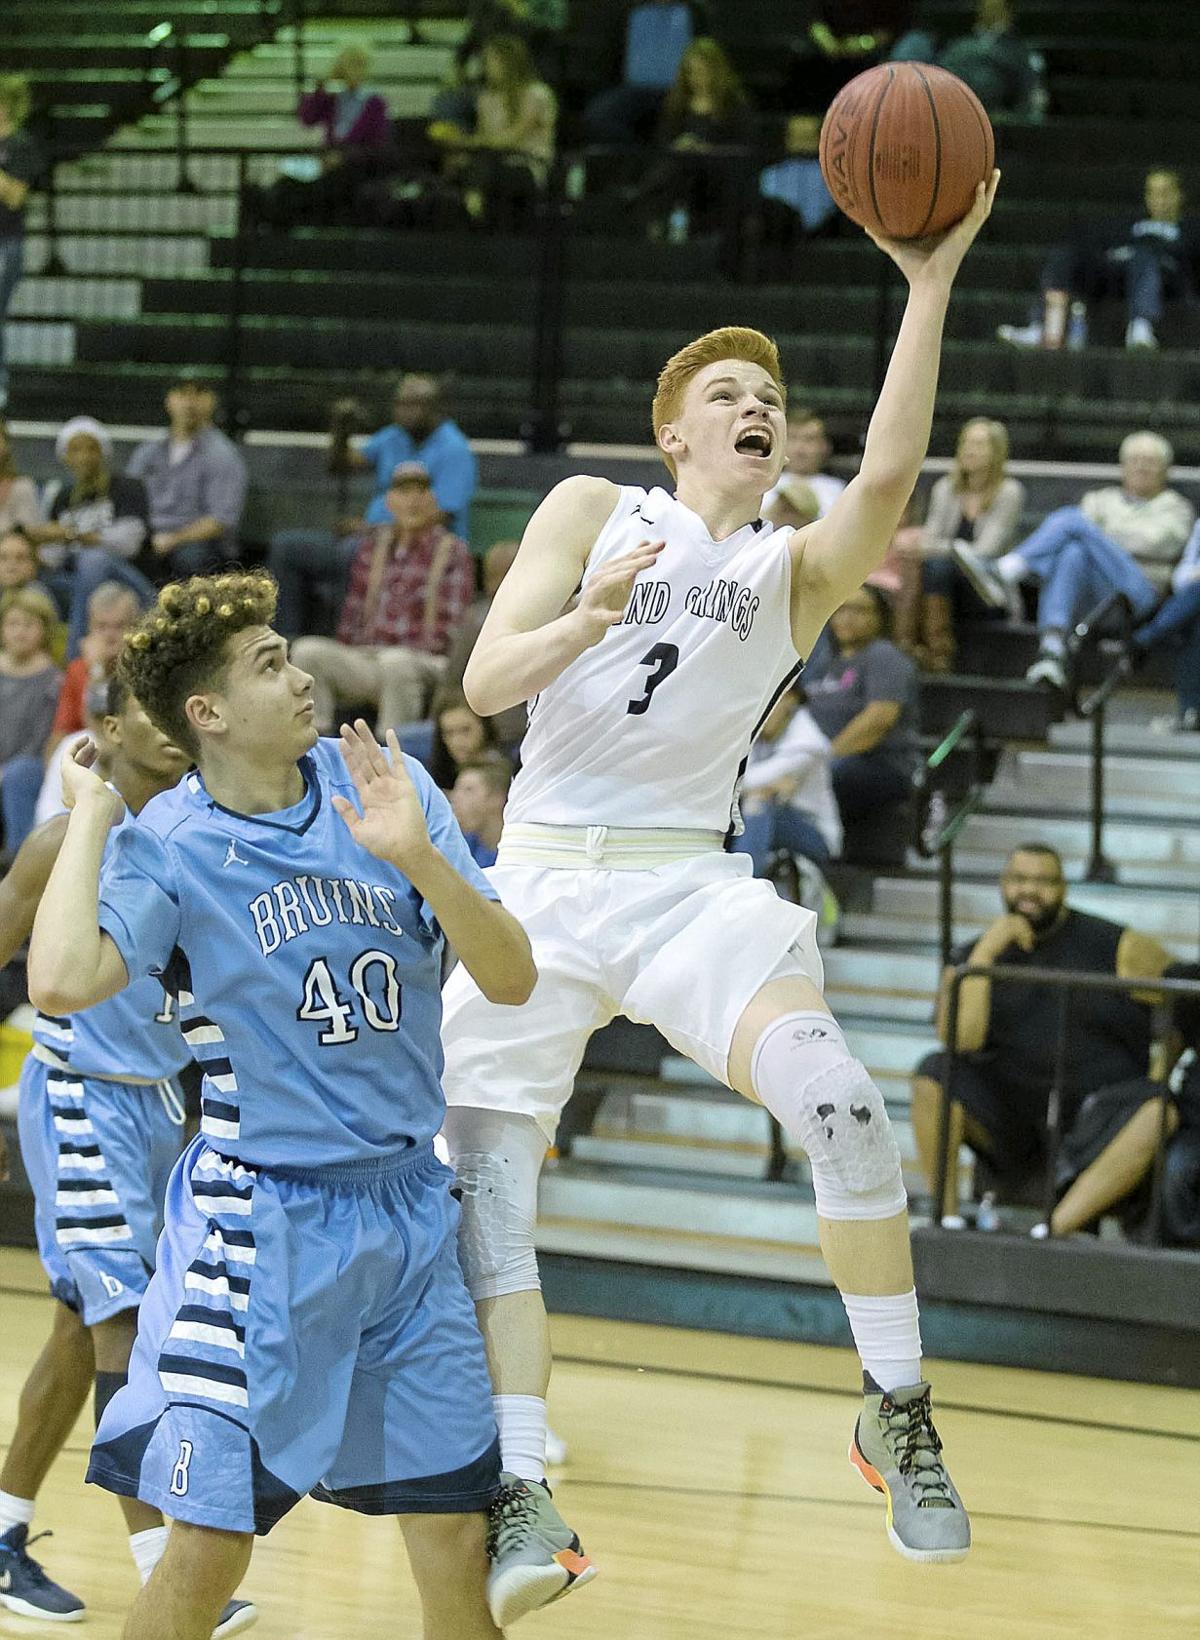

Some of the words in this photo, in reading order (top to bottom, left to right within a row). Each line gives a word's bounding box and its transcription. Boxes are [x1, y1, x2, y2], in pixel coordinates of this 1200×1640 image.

[611, 581, 671, 626] ND
[626, 642, 680, 716] 3
[248, 874, 404, 958] BRUINS
[296, 948, 402, 1047] 40
[170, 1439, 193, 1497] B
